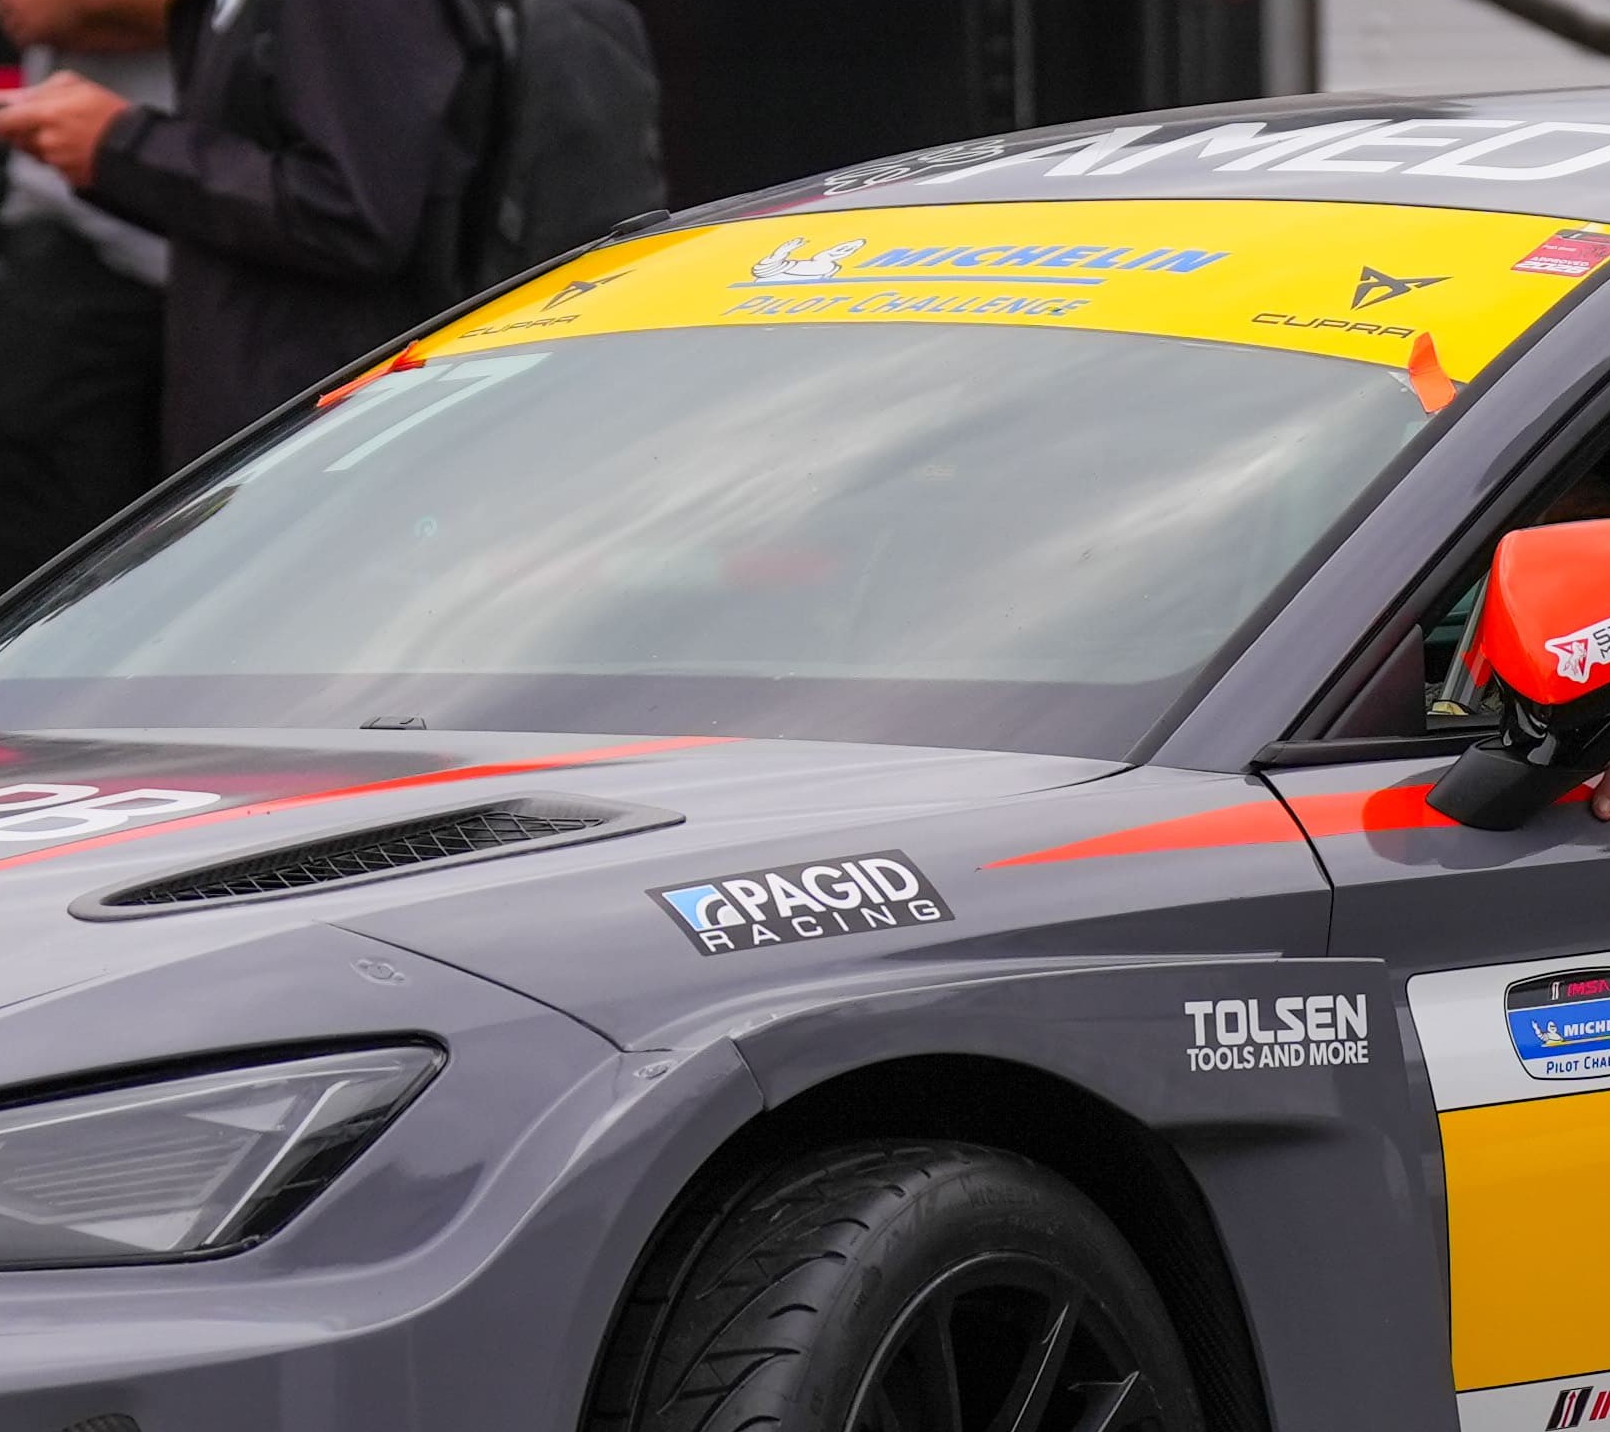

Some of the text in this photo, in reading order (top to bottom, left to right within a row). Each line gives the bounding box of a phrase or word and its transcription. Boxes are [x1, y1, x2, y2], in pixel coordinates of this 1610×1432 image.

[855, 245, 1233, 273] MICHELIN
[720, 291, 1090, 318] PILOT CHALLENGE
[458, 313, 582, 339] CUPRA
[1250, 312, 1416, 339] CUPRA
[728, 856, 921, 925] PAGID
[699, 897, 941, 954] RACING
[1183, 992, 1369, 1048] TOLSEN
[1187, 1039, 1370, 1073] TOOLS AND MORE
[1546, 1057, 1580, 1076] PILOT
